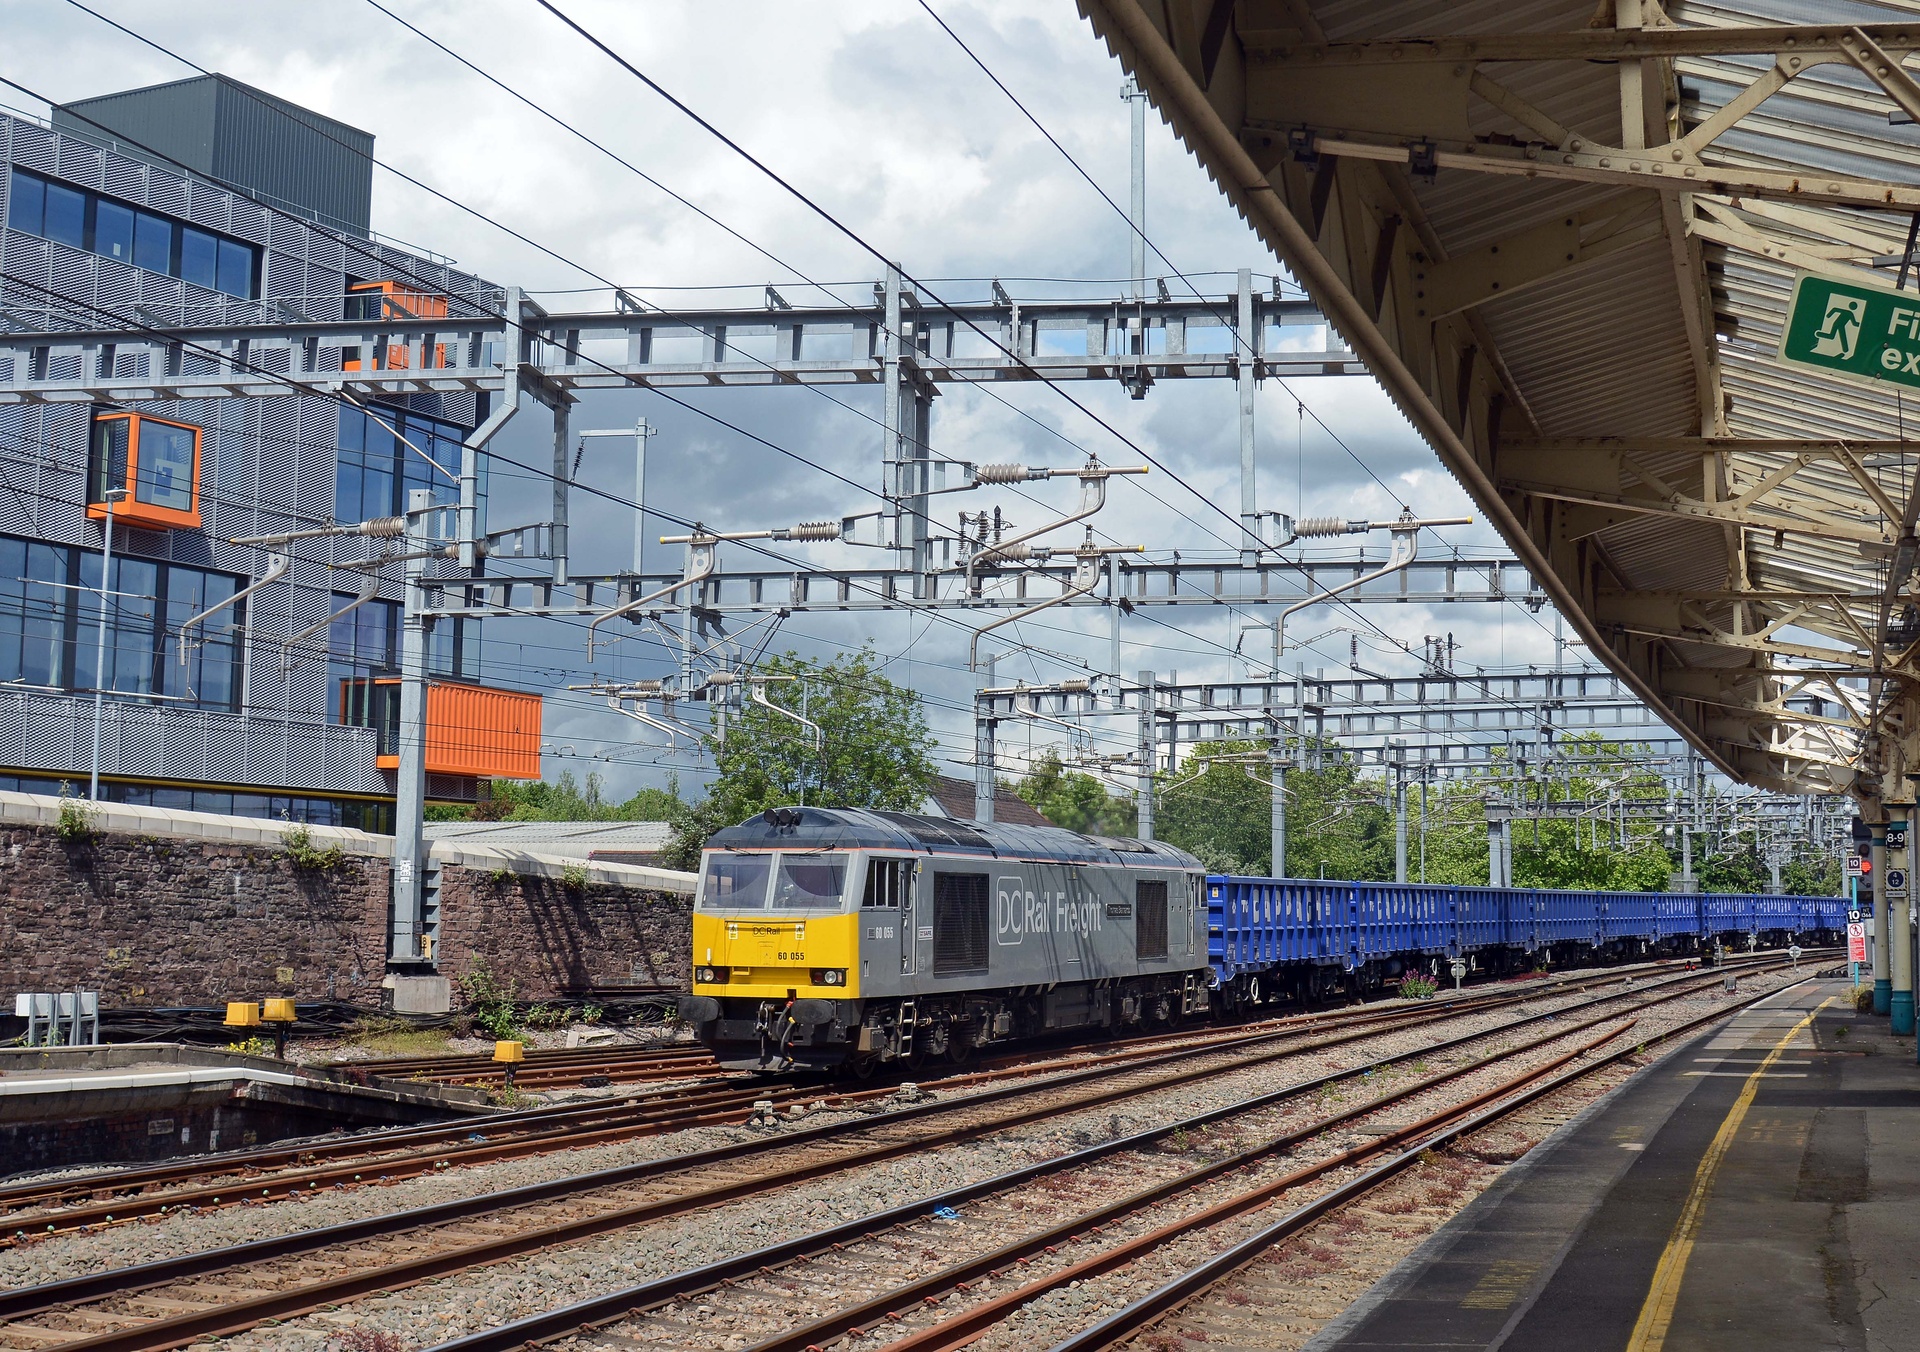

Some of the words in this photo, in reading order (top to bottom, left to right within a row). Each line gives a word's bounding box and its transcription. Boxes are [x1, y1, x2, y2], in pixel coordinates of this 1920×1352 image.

[1888, 307, 1920, 341] Fi
[1887, 833, 1904, 843] 8-9
[1056, 892, 1102, 939] Freight
[1847, 910, 1860, 920] 10
[876, 926, 882, 939] 60
[884, 926, 894, 939] 055
[777, 952, 788, 961] 60
[790, 952, 805, 961] 055
